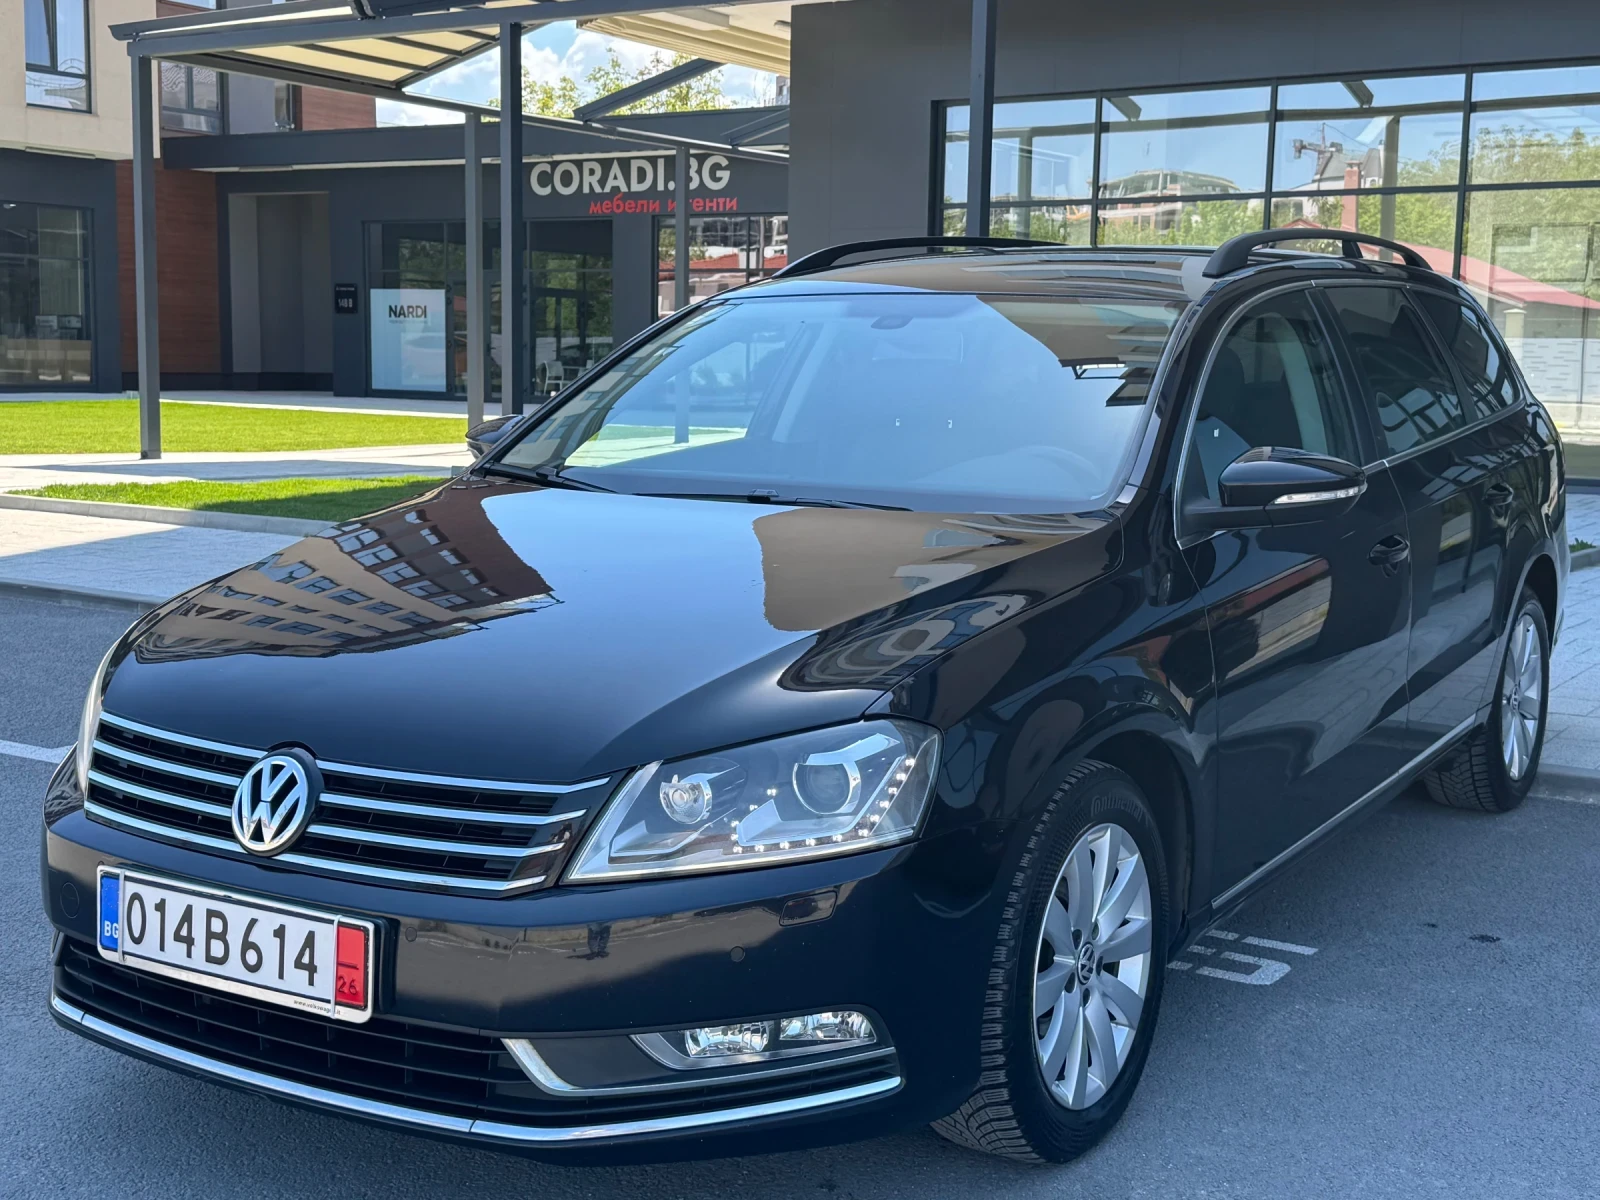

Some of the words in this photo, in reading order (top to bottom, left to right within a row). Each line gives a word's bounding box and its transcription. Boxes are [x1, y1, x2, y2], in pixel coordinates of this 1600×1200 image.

[530, 155, 730, 196] CORADI.BG
[589, 192, 660, 215] мебели
[388, 304, 427, 318] NARDI
[104, 920, 119, 939] BG
[126, 892, 318, 987] 014B614
[337, 975, 358, 996] 26
